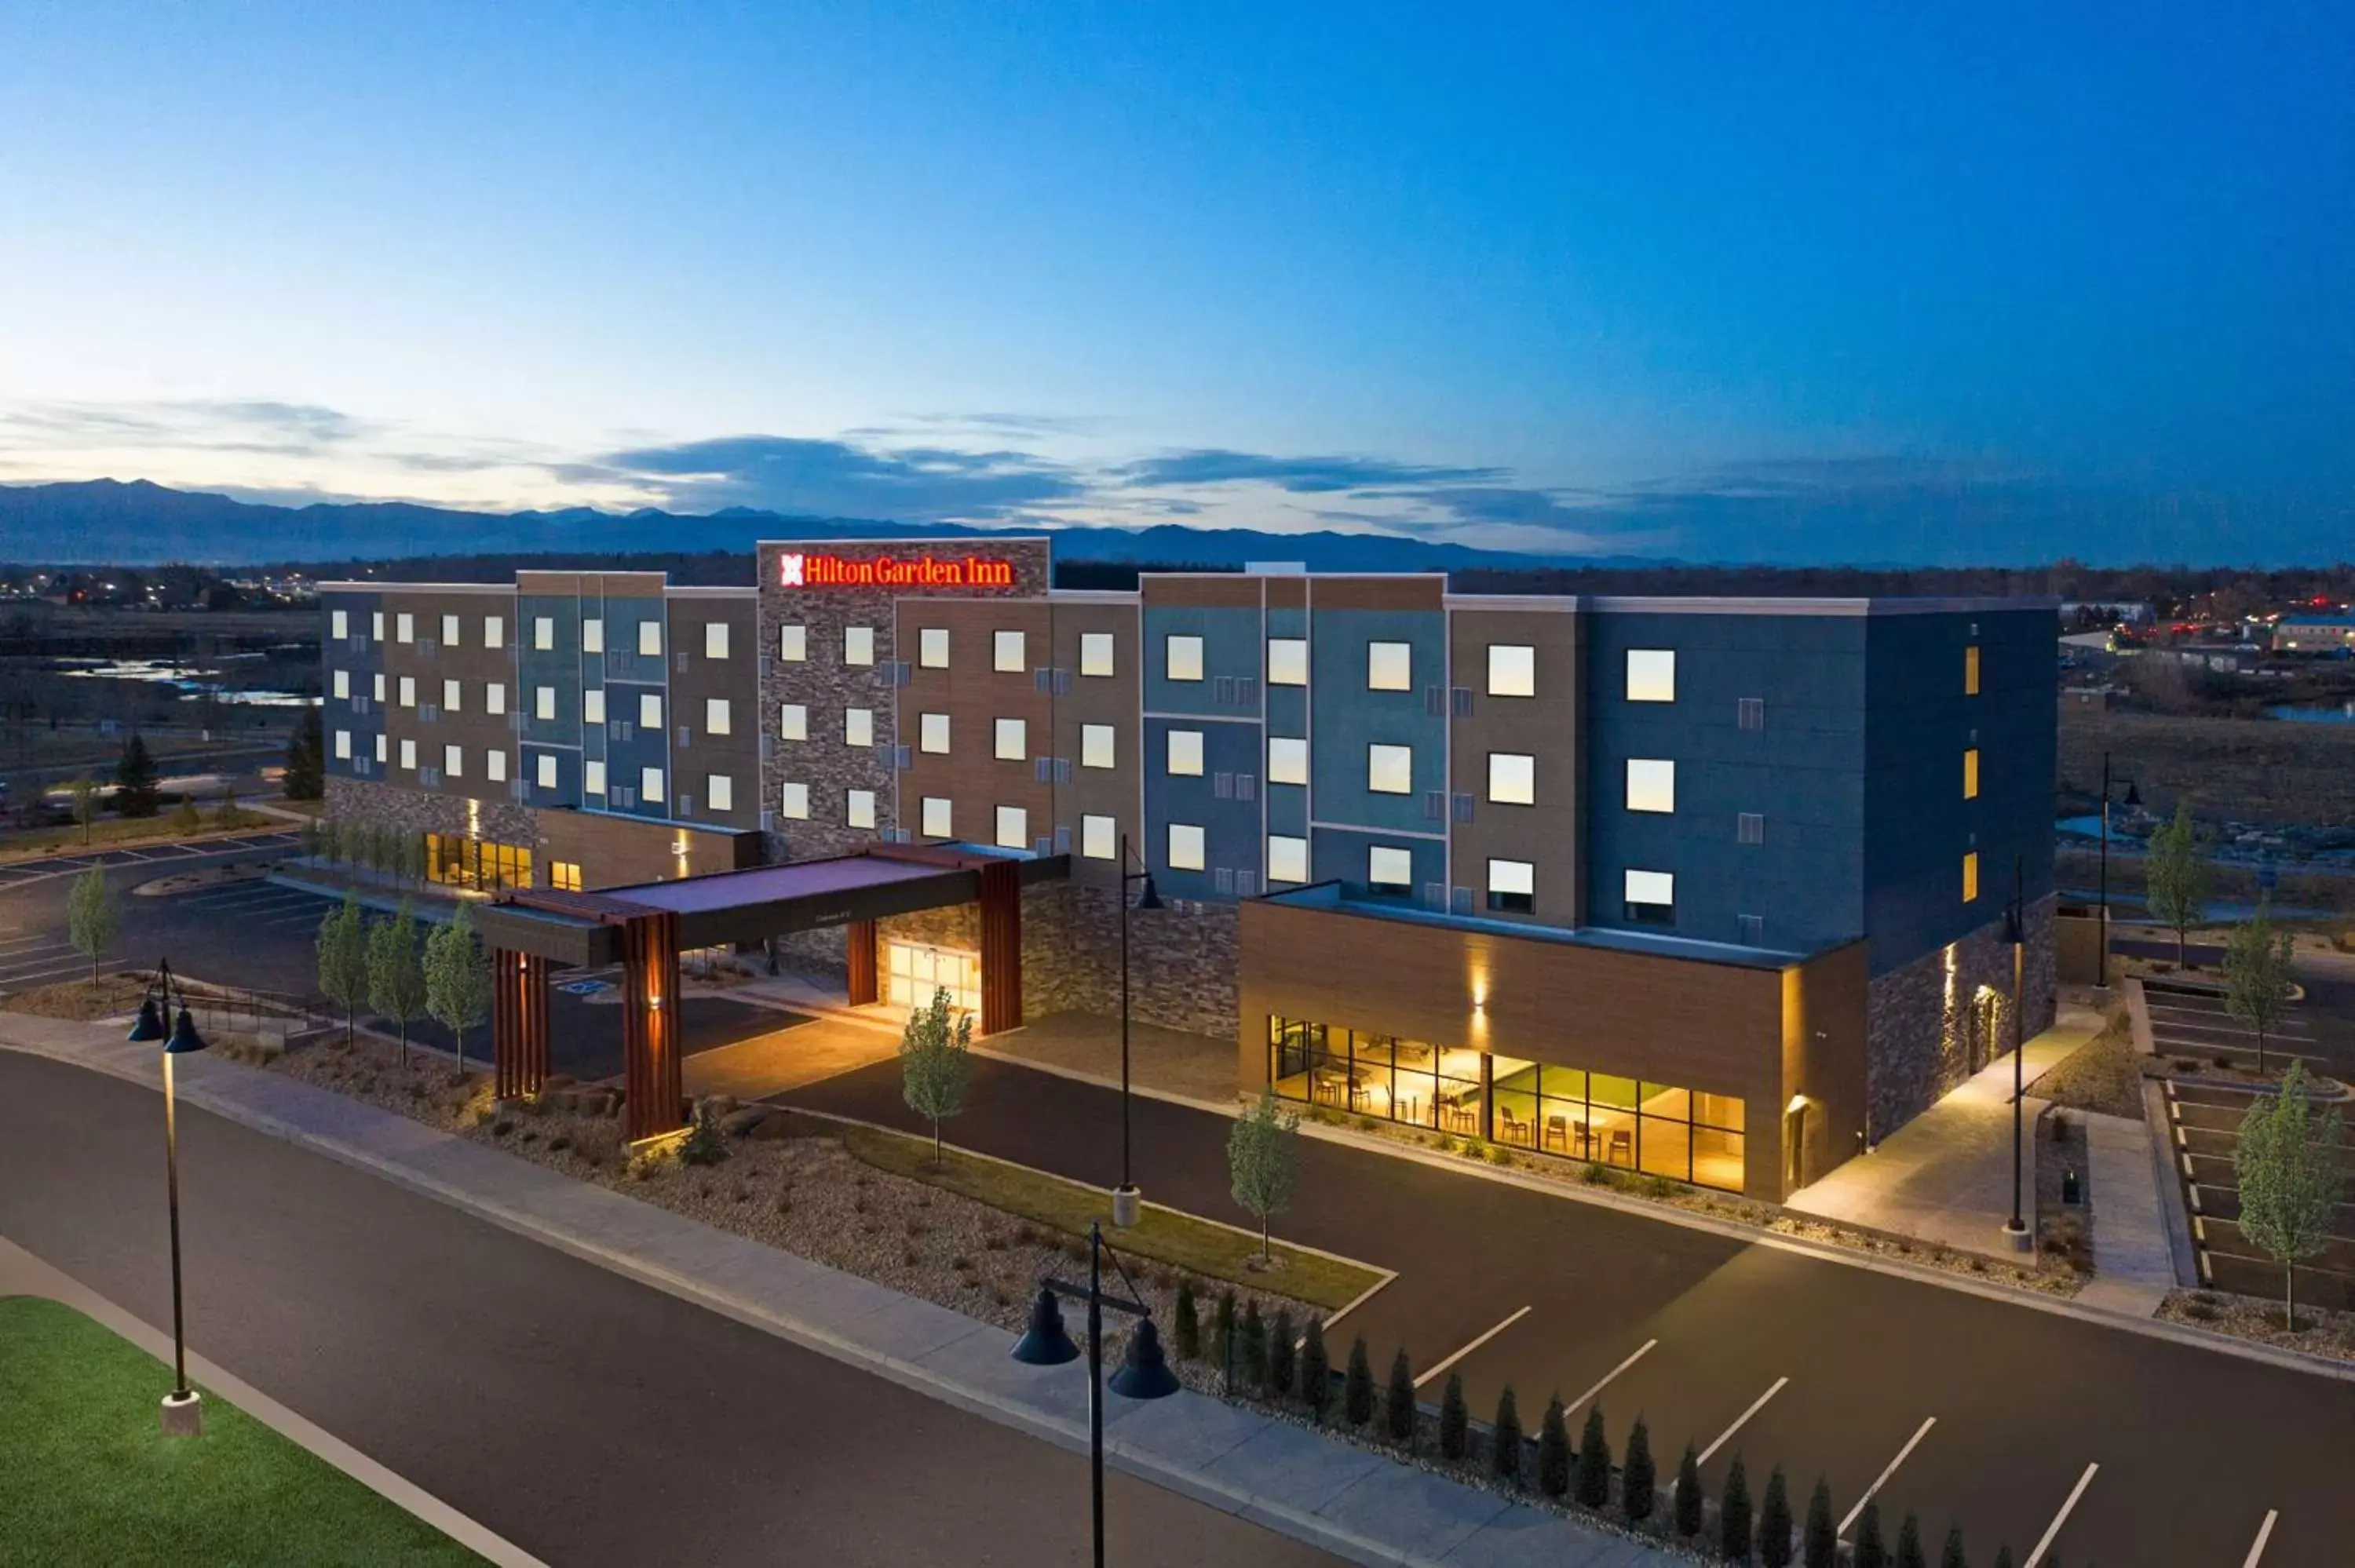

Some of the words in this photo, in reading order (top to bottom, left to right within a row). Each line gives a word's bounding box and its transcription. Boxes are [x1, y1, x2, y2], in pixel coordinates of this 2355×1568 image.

[805, 555, 873, 583] Hilton
[876, 556, 962, 584] Garden
[967, 556, 1012, 584] Inn
